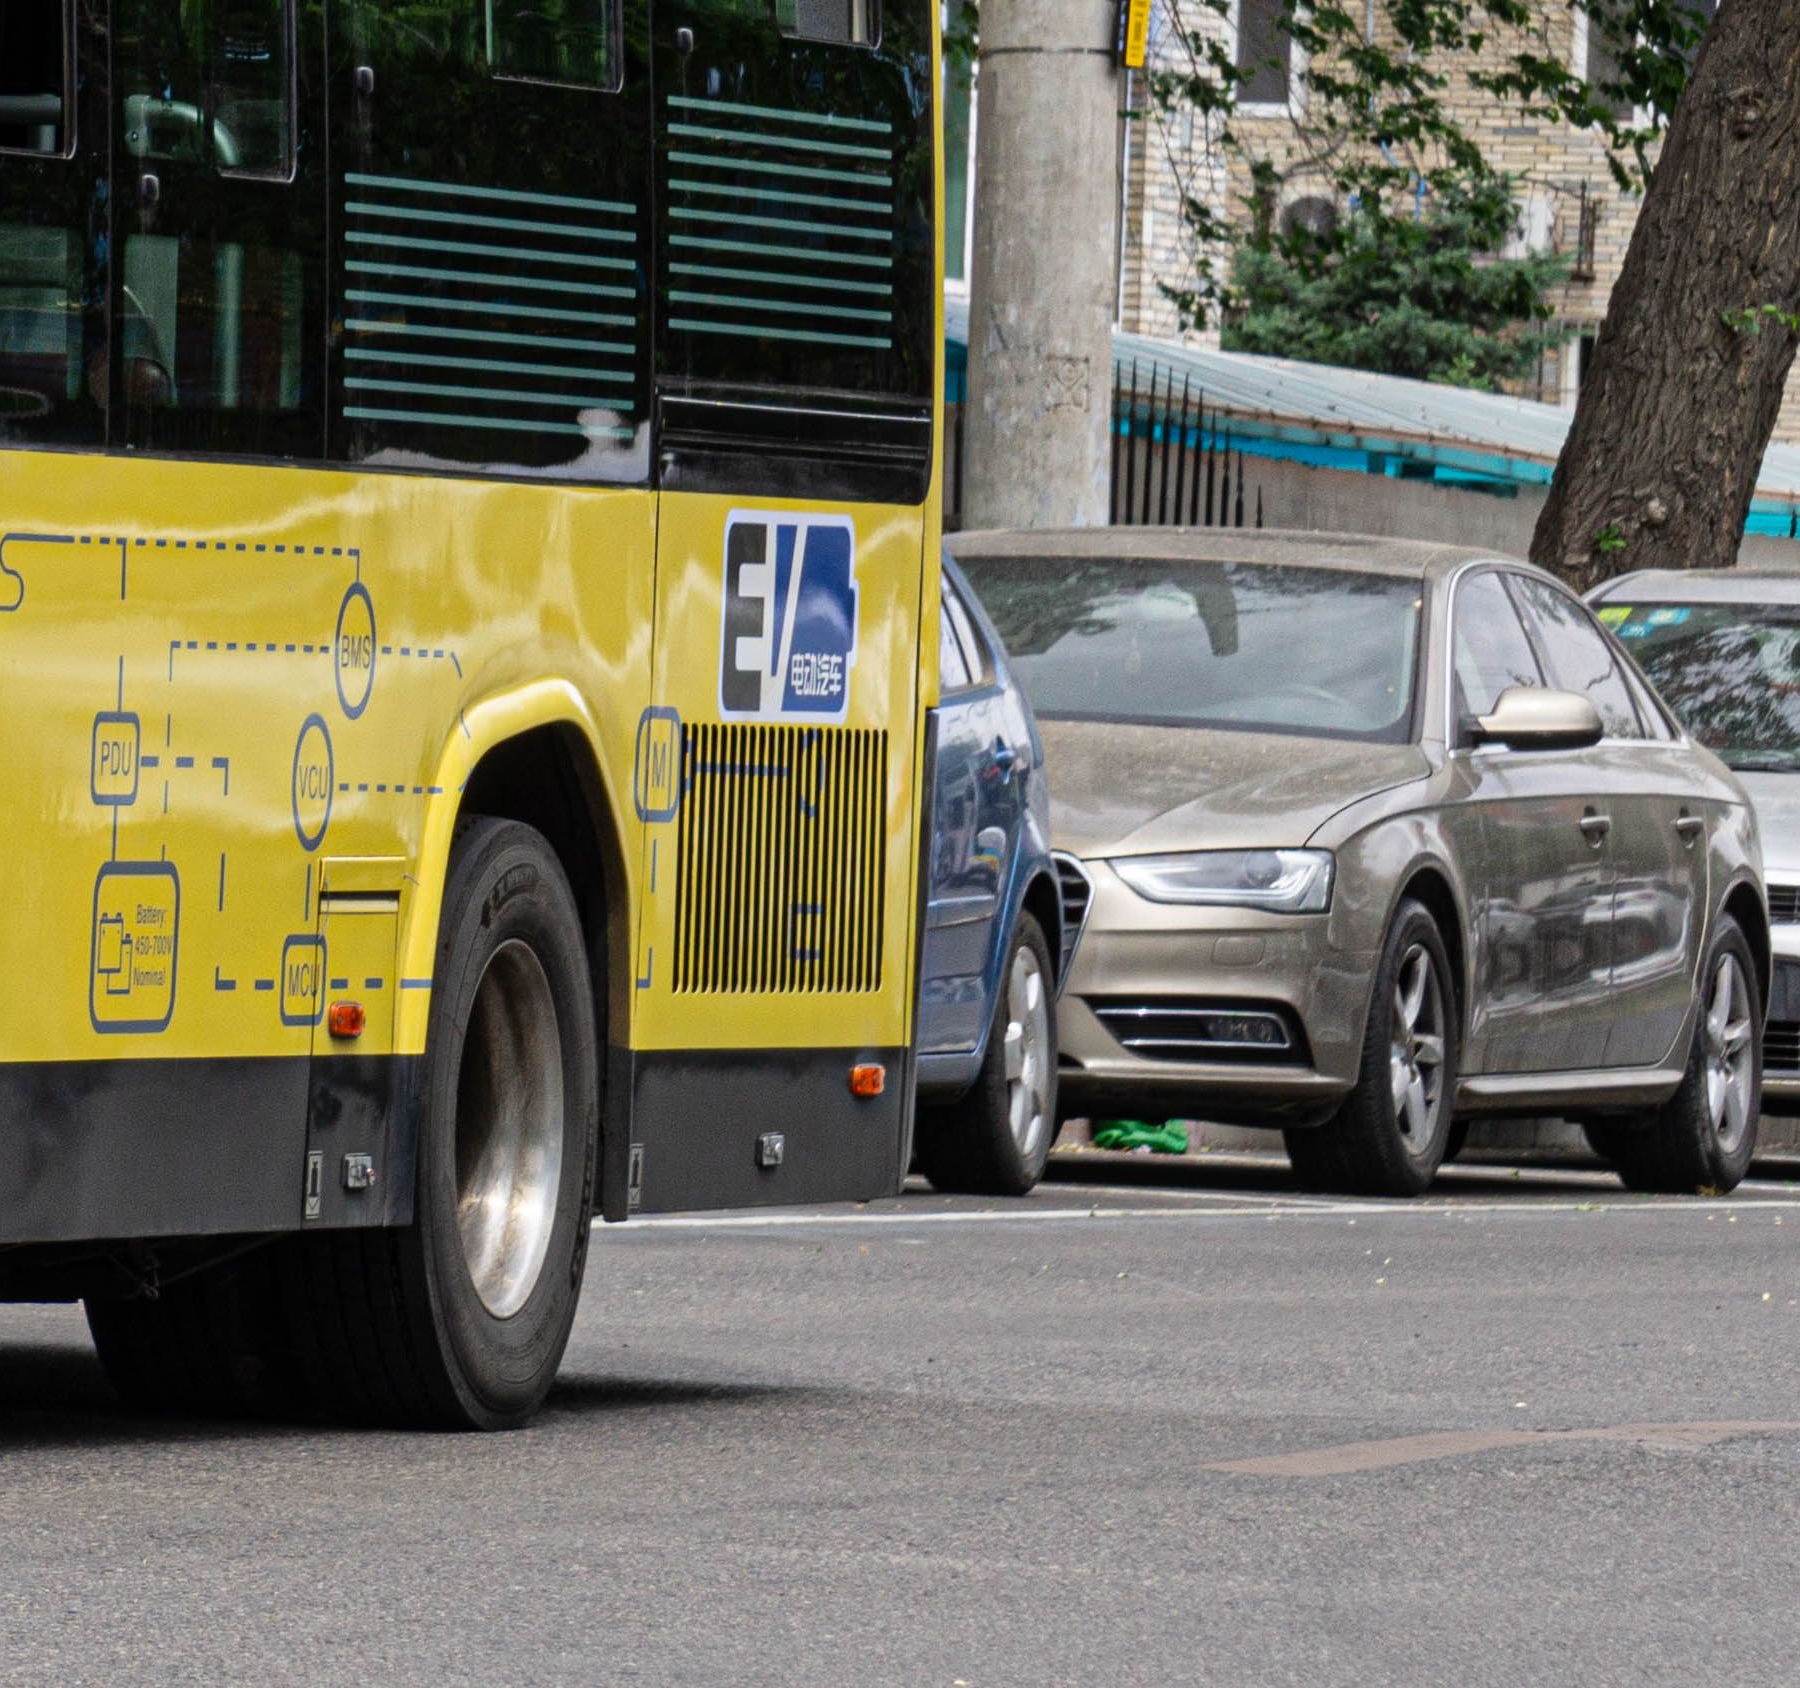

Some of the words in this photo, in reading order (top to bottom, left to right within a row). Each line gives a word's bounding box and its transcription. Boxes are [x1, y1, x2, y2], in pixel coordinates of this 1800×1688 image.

[340, 635, 372, 670] BMS
[791, 652, 843, 697] 电动汽车
[100, 740, 132, 777] PDU
[299, 765, 330, 800] VCU
[133, 967, 166, 987] Nominal
[288, 962, 320, 998] MCU
